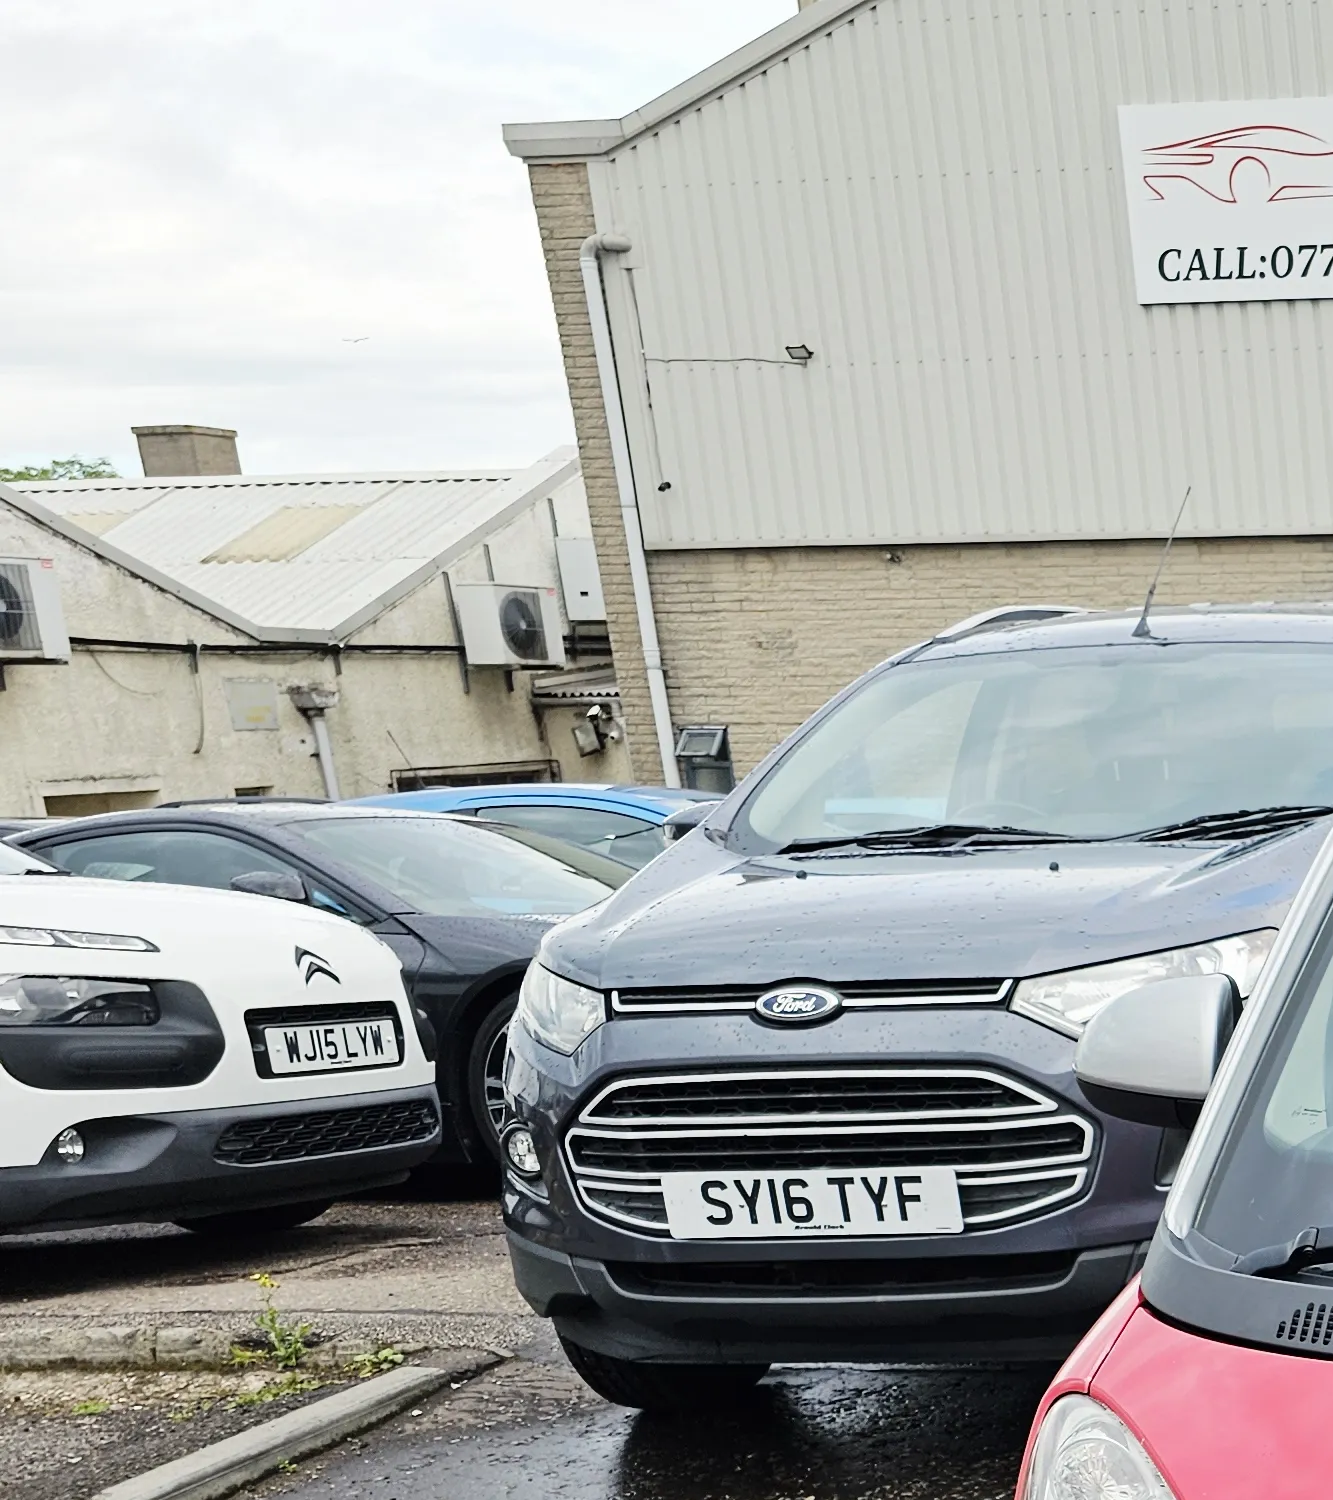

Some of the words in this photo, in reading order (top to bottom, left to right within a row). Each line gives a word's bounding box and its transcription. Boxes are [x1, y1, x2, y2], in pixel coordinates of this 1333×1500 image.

[773, 993, 817, 1013] Ford
[283, 1029, 339, 1063] WJ15
[342, 1024, 385, 1058] LYW
[700, 1178, 815, 1226] SY16
[826, 1175, 922, 1224] TYF
